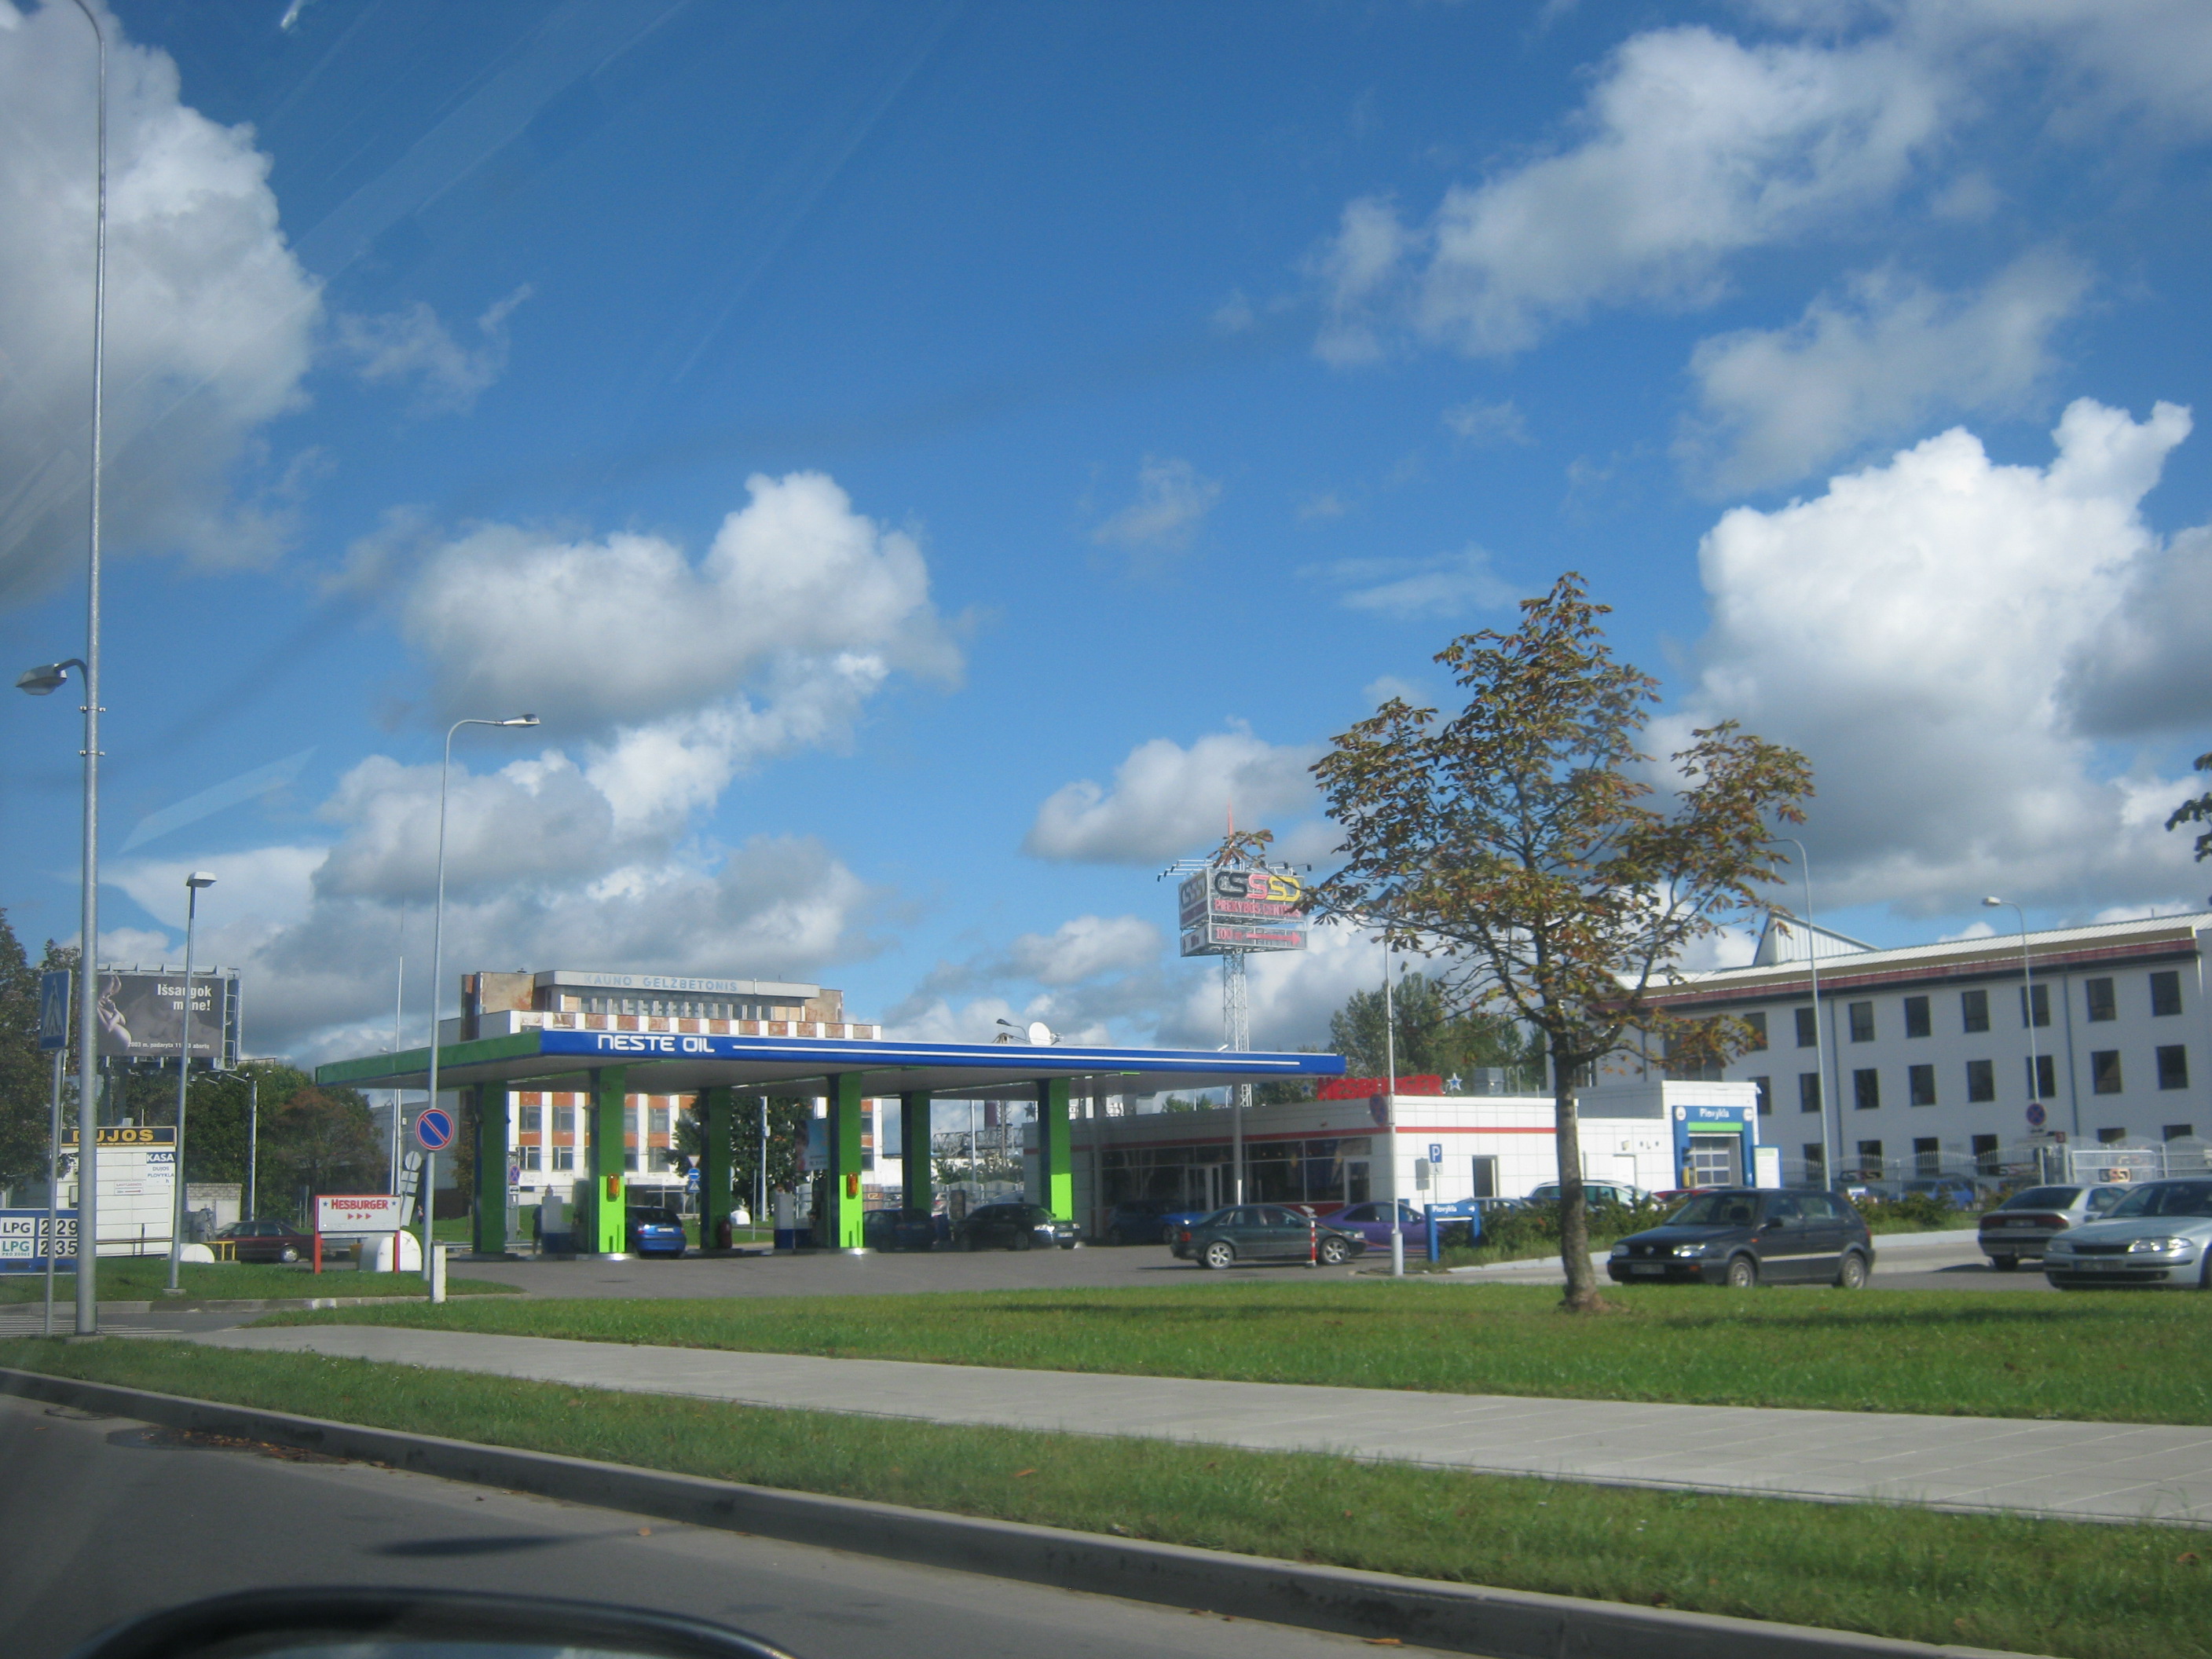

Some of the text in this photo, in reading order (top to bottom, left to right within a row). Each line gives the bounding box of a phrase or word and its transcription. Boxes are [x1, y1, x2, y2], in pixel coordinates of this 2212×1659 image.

[584, 973, 632, 986] KAUNO
[173, 1000, 211, 1011] mne!
[598, 1034, 716, 1053] NESTE OIL
[147, 1153, 174, 1163] KASA
[1432, 1145, 1441, 1161] P
[331, 1199, 389, 1210] HESBURGER
[3, 1222, 31, 1233] LPG
[2, 1241, 30, 1251] LPG
